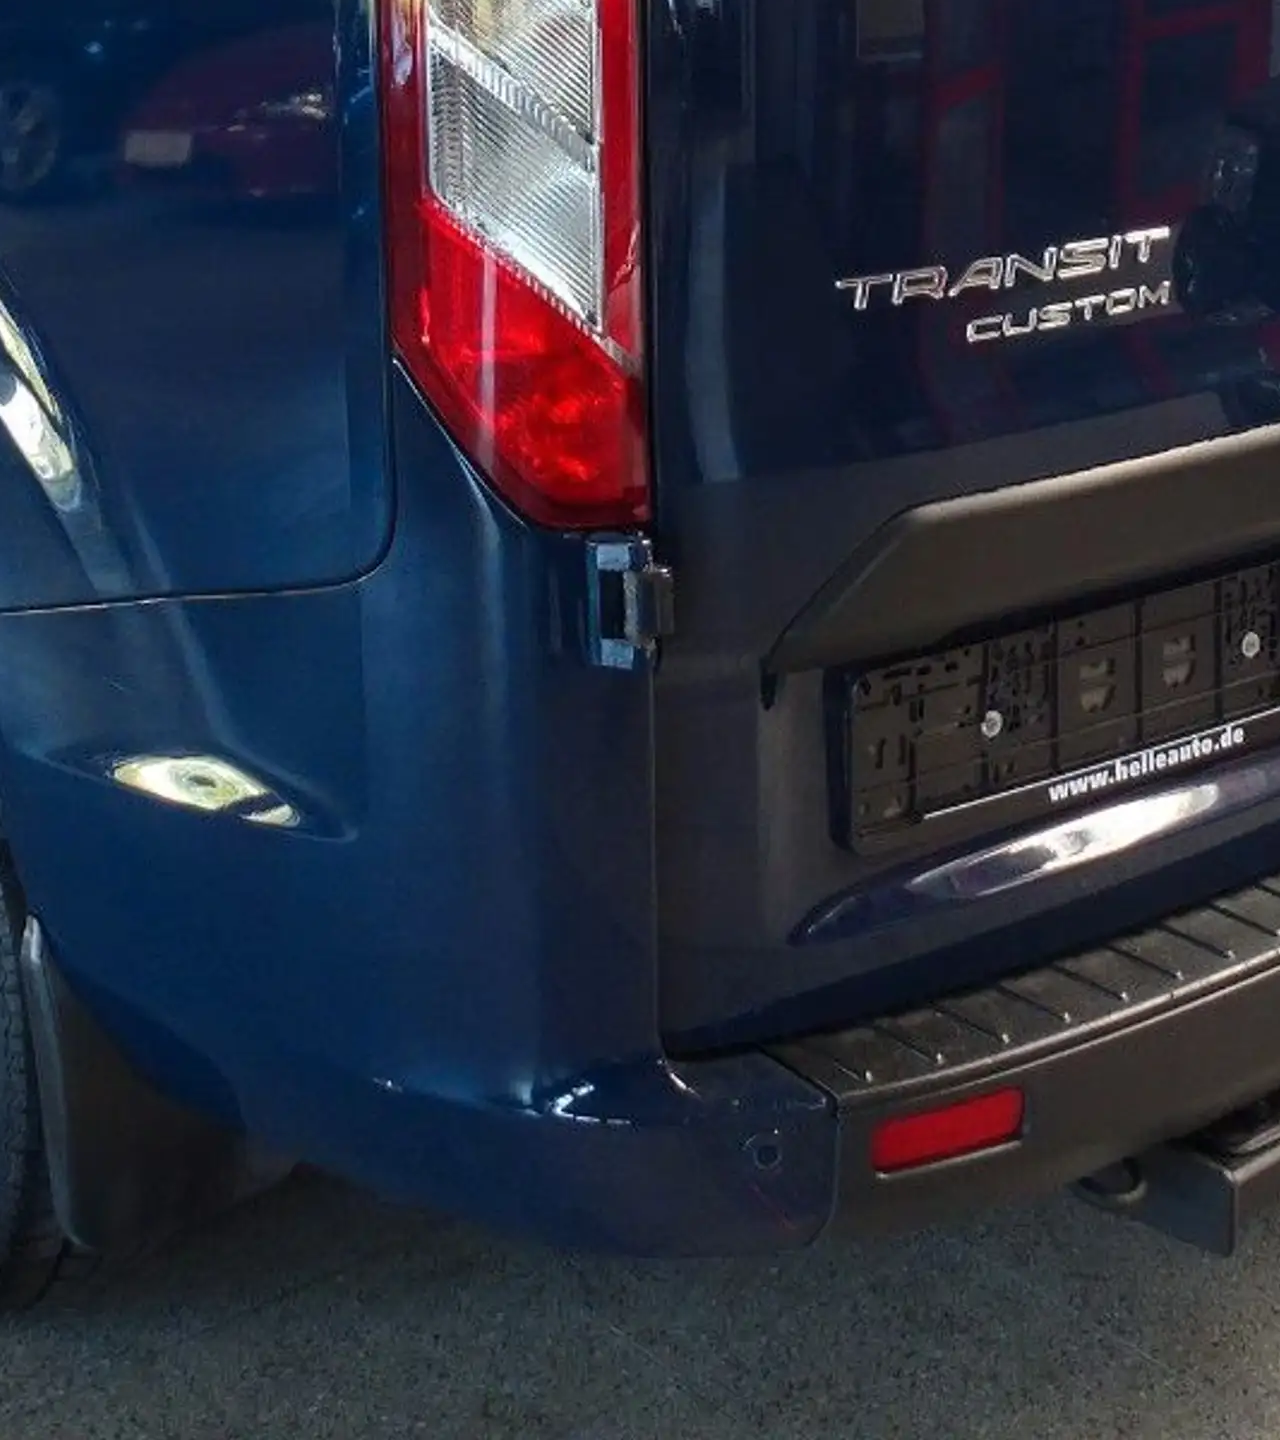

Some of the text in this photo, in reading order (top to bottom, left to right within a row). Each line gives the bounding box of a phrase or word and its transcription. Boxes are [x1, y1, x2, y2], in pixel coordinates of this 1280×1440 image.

[835, 225, 1171, 310] TRANSIT
[965, 280, 1172, 343] CUSTOM
[1048, 724, 1245, 802] www.helleauto.de
